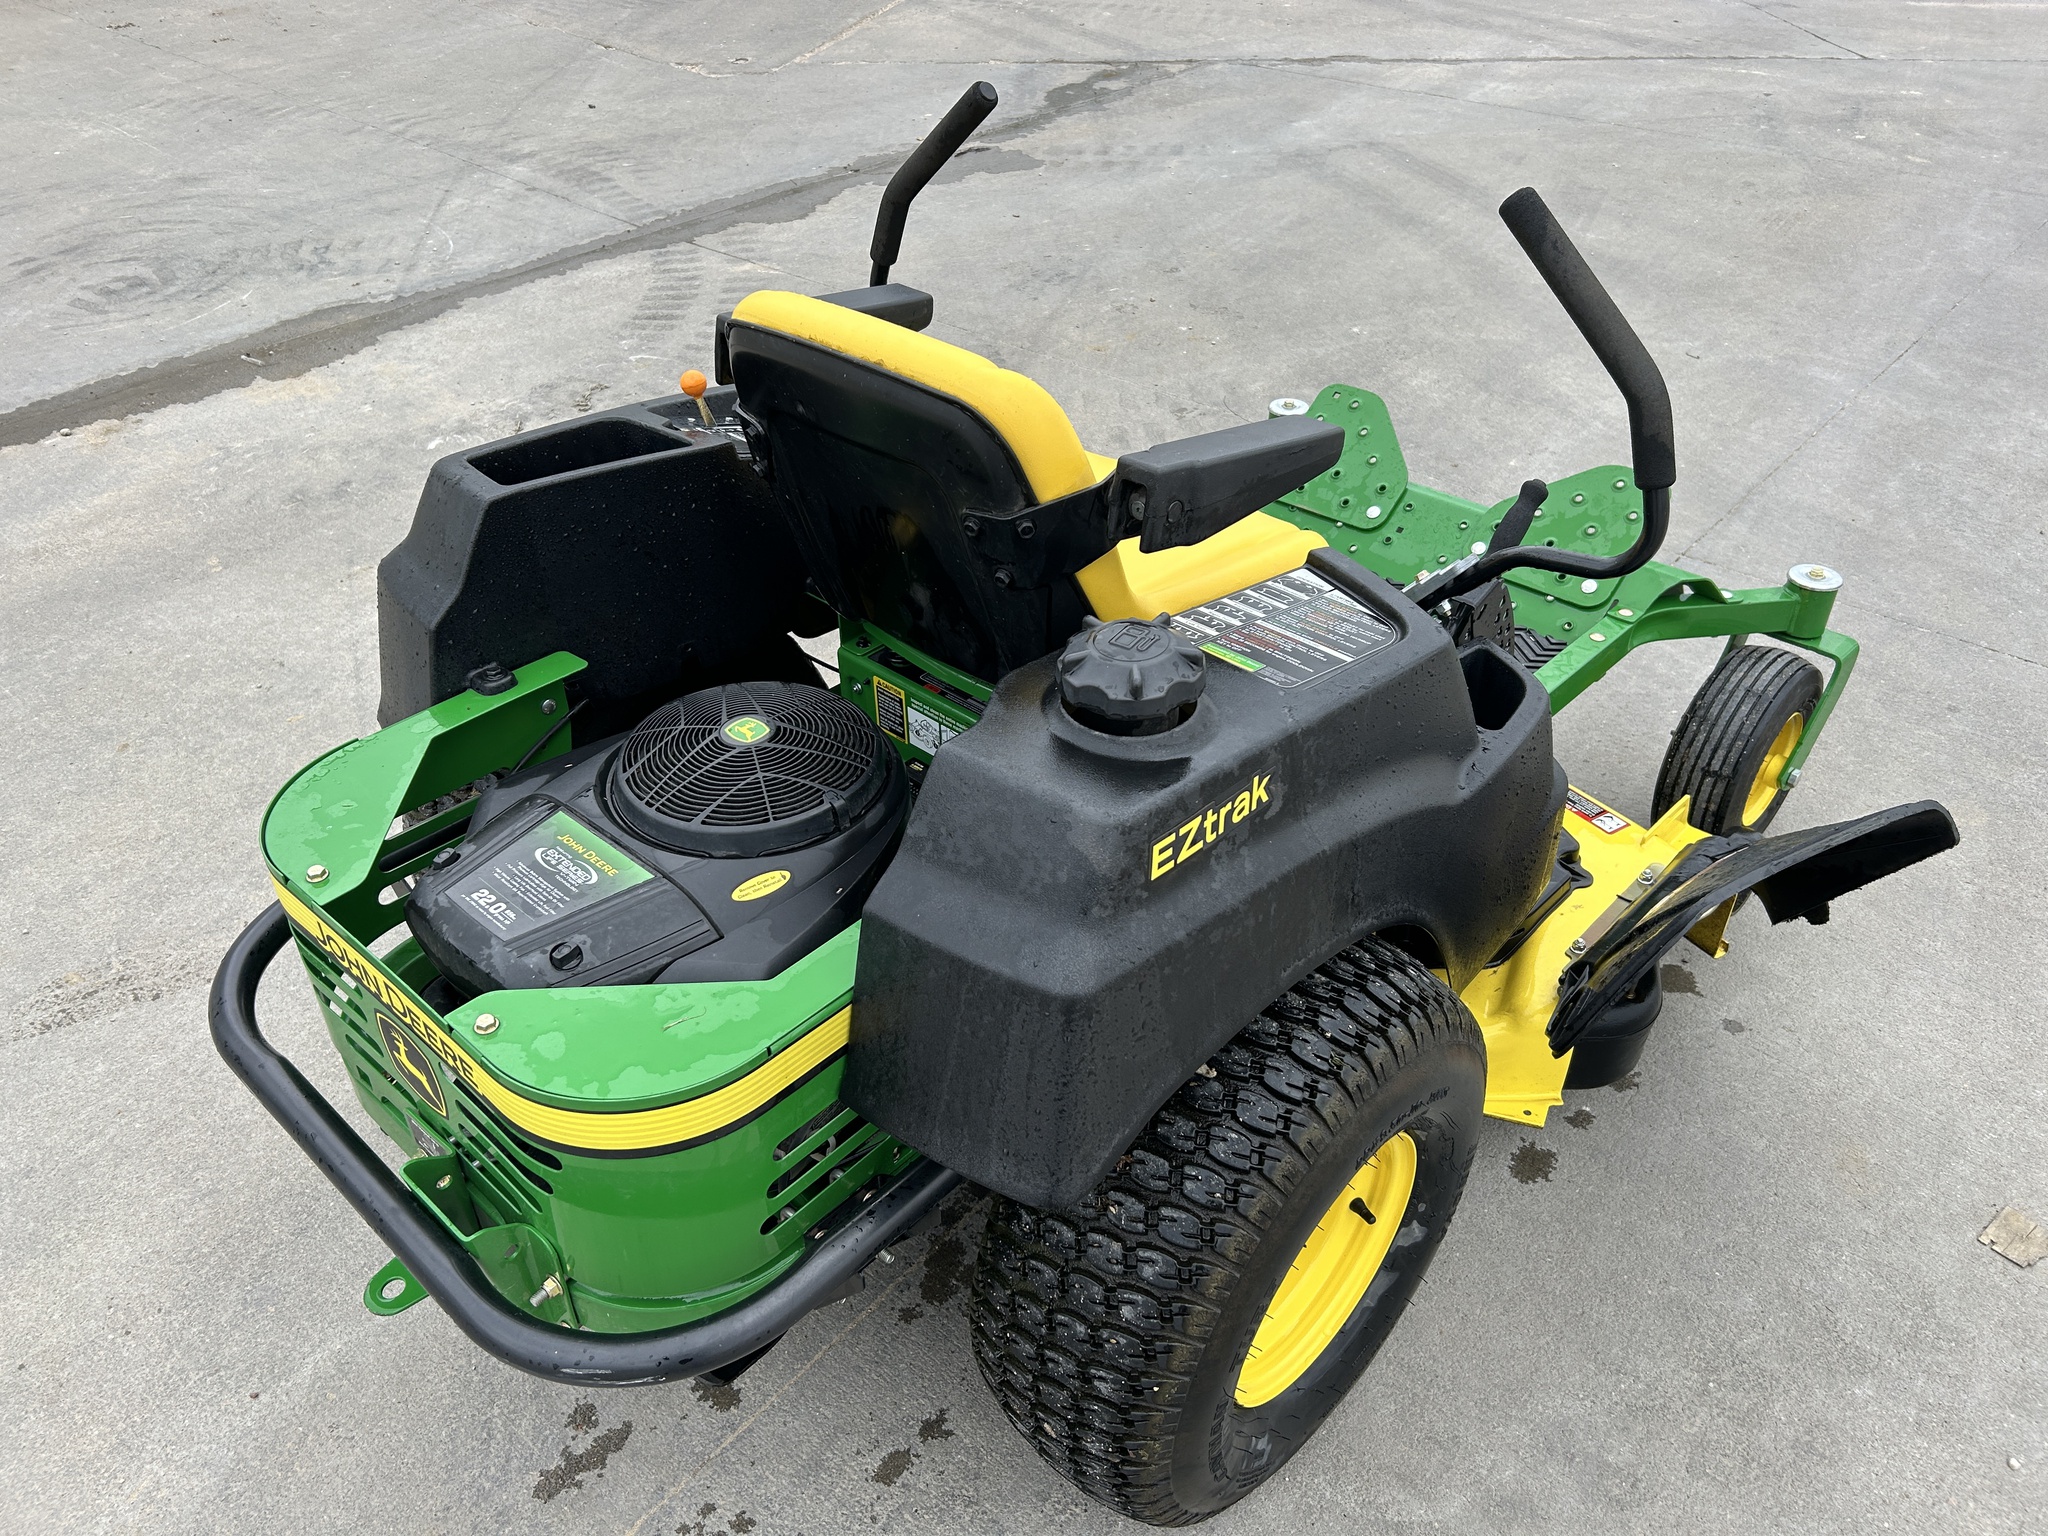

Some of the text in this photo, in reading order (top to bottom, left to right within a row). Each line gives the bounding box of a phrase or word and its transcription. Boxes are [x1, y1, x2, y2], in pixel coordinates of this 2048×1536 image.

[881, 682, 902, 697] CAUTION
[1150, 774, 1271, 881] EZtrak
[542, 853, 557, 866] LIFE
[556, 865, 585, 884] SERIES
[546, 849, 591, 881] EXTENDED
[556, 834, 619, 877] JOHN DEERE
[470, 888, 507, 914] 22.0
[314, 921, 482, 1090] JOHN DEERE
